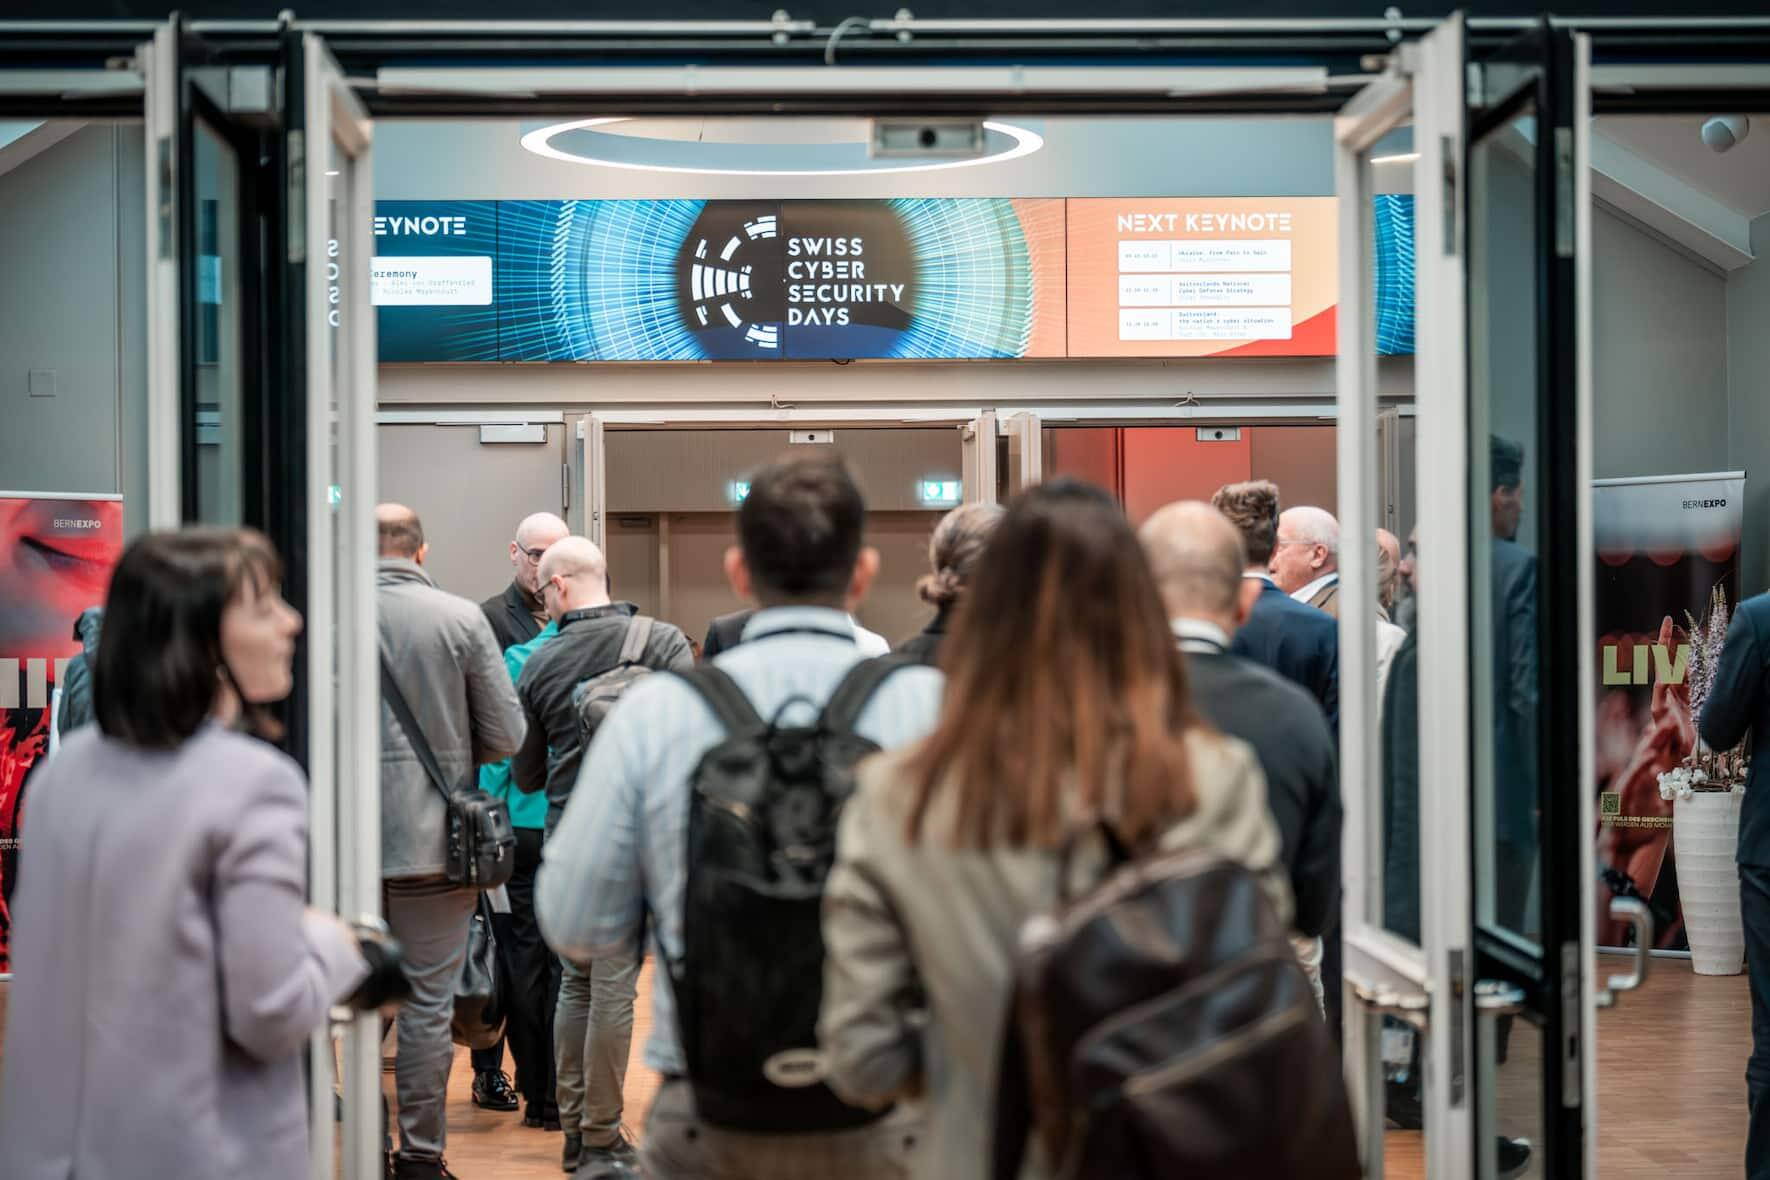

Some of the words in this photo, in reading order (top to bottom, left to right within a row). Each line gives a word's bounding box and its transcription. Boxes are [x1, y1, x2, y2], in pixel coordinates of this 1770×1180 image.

[370, 216, 467, 235] EYNOTE
[1117, 213, 1178, 232] NEXT
[1186, 212, 1292, 231] KEYNOTE
[787, 237, 864, 256] SWISS
[371, 270, 418, 280] eremony
[787, 261, 865, 279] CYBER
[787, 284, 905, 302] SECURITY
[787, 307, 849, 326] DAYS
[1682, 499, 1727, 510] BERNEXPO
[53, 519, 102, 529] BERNEXPO
[1603, 644, 1690, 685] LIV
